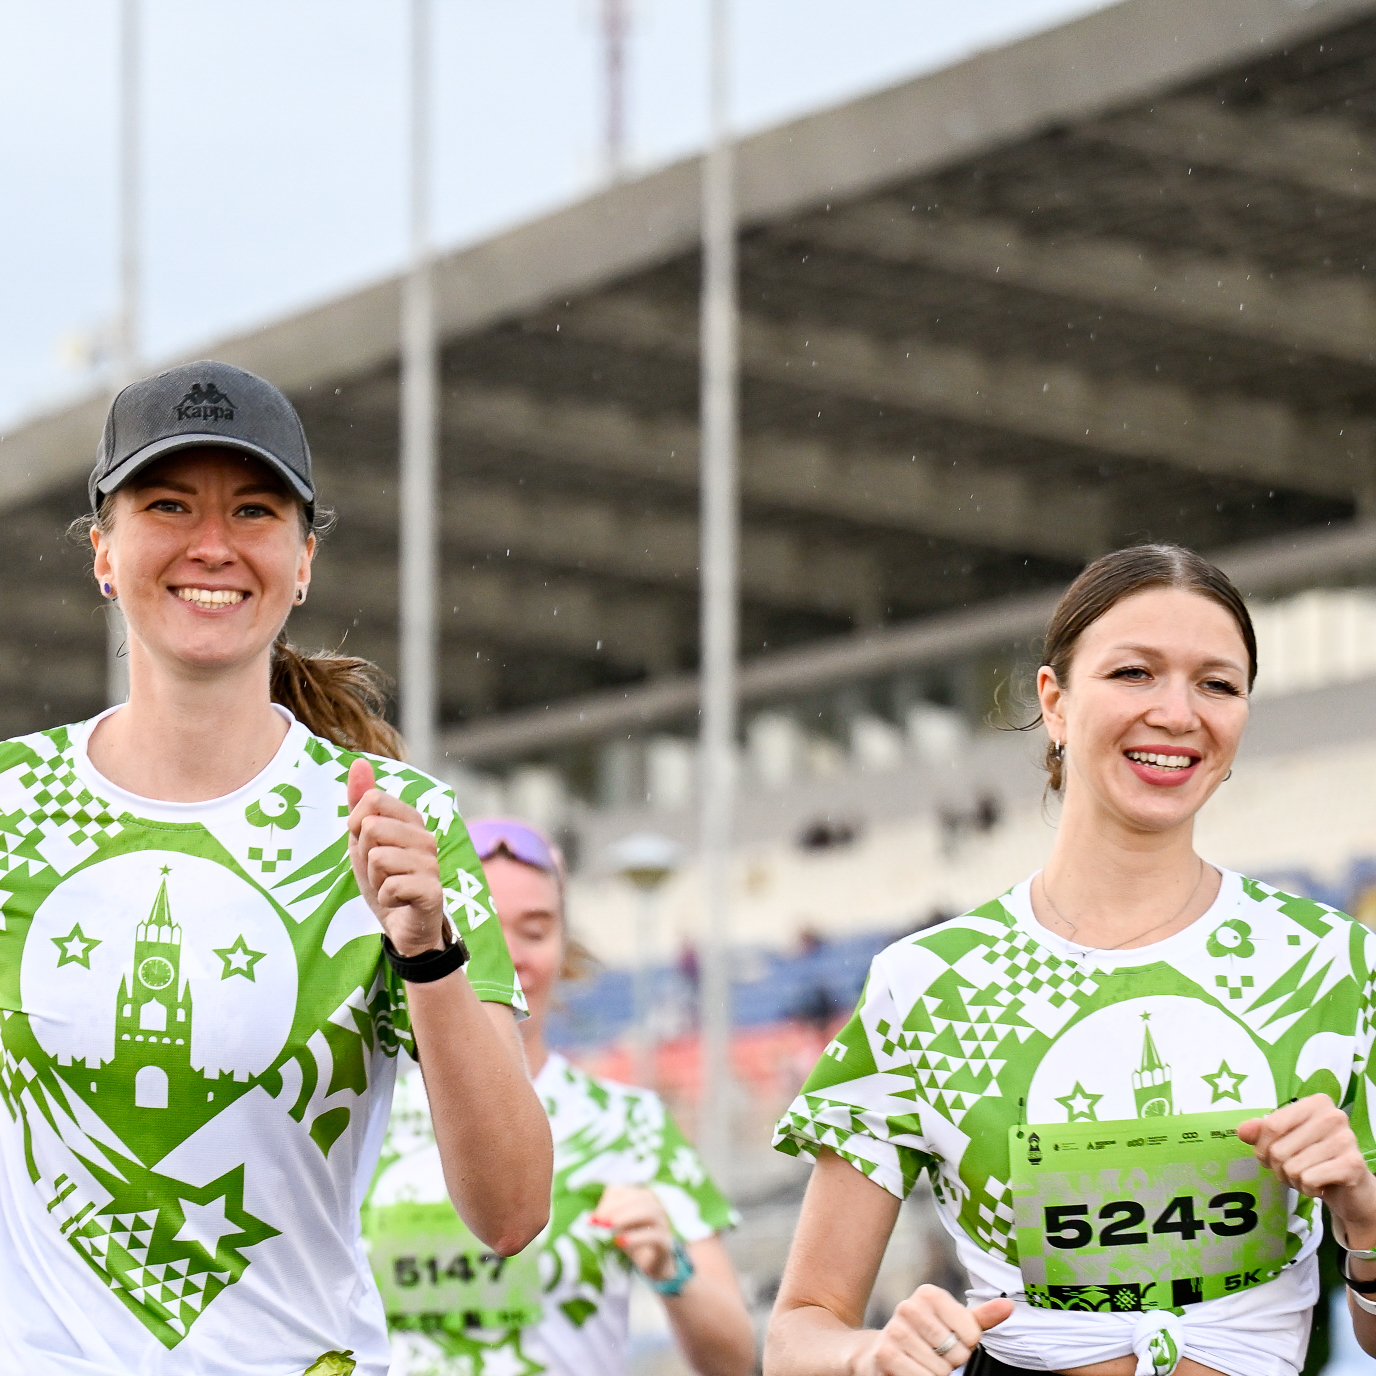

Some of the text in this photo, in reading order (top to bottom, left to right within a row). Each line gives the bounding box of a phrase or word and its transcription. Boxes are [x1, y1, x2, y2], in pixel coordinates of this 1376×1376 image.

[177, 405, 234, 421] Kappa
[1045, 1191, 1258, 1249] 5243
[394, 1254, 506, 1286] 5147
[1224, 1268, 1262, 1291] 5K
